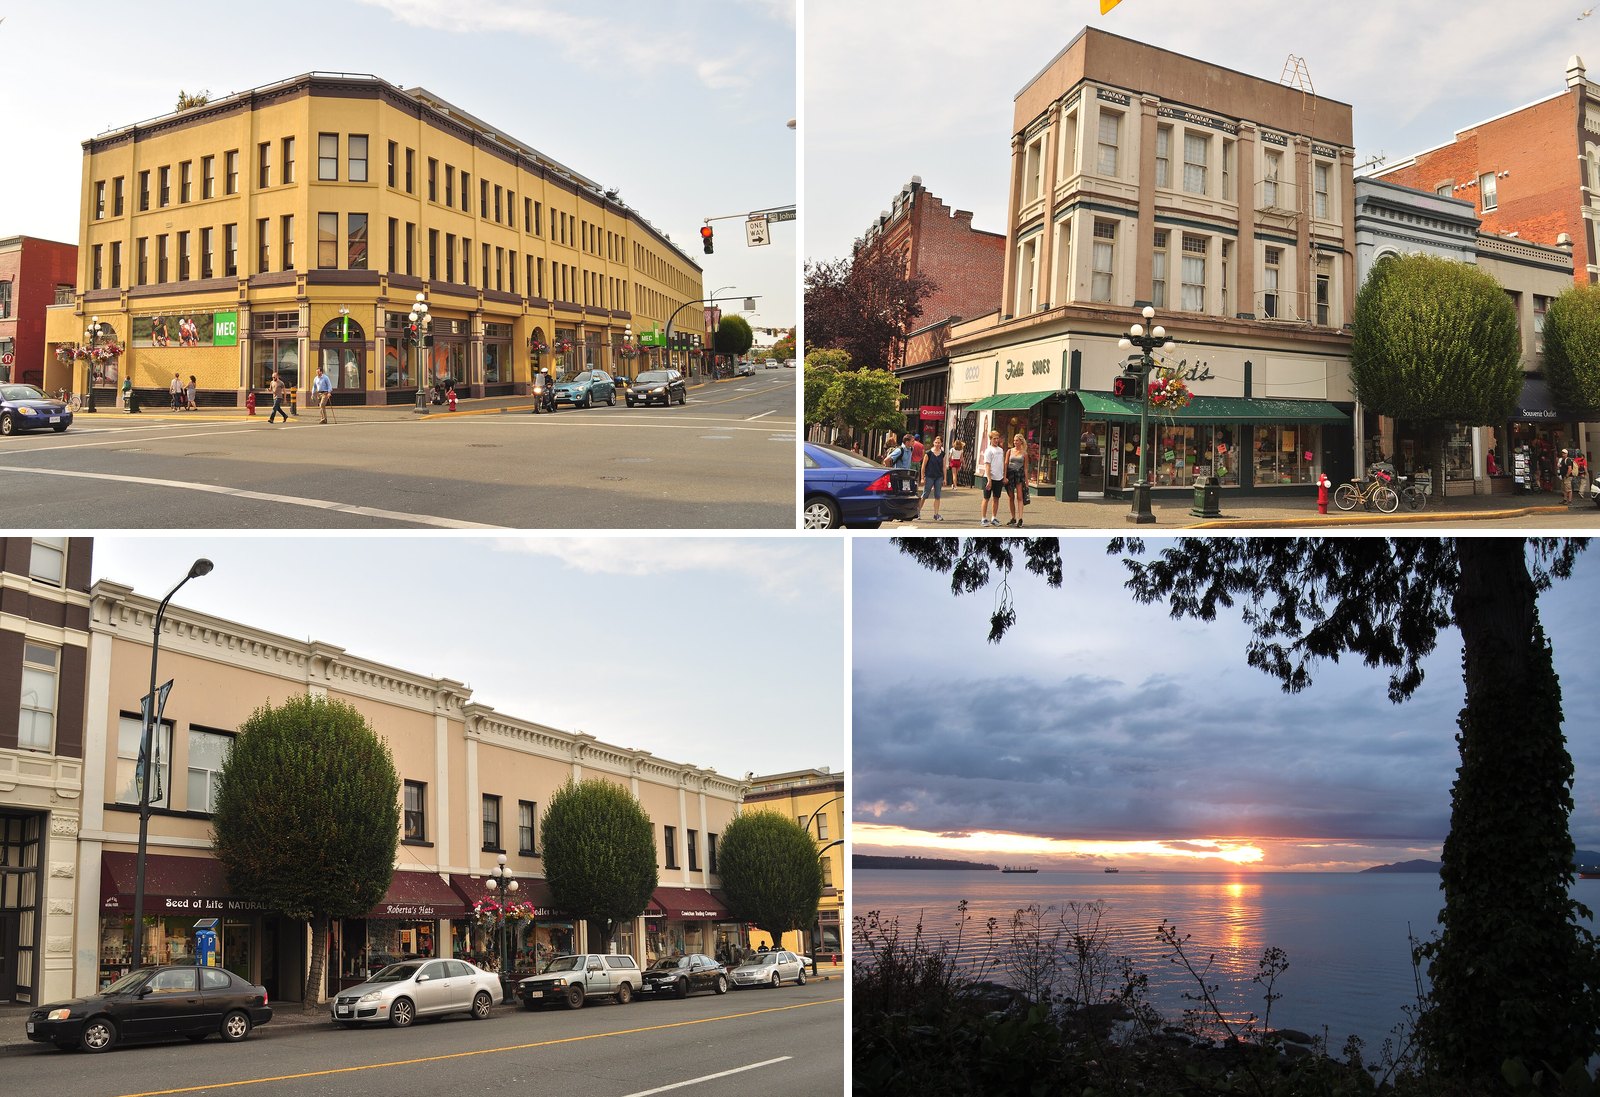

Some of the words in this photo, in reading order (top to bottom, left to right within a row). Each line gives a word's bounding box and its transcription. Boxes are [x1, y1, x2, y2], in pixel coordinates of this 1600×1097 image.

[779, 212, 796, 221] John
[750, 229, 764, 237] WAY
[215, 321, 235, 336] MEC
[1031, 358, 1051, 376] SHOES
[1522, 408, 1543, 418] Souvenir
[1543, 409, 1557, 418] Outlet
[165, 898, 189, 908] Seed
[192, 899, 202, 908] of
[205, 899, 224, 909] Life
[228, 901, 267, 910] NATURAL
[386, 904, 417, 915] Roberta's
[418, 905, 435, 915] Hats
[197, 937, 202, 946] P
[208, 937, 213, 946] P
